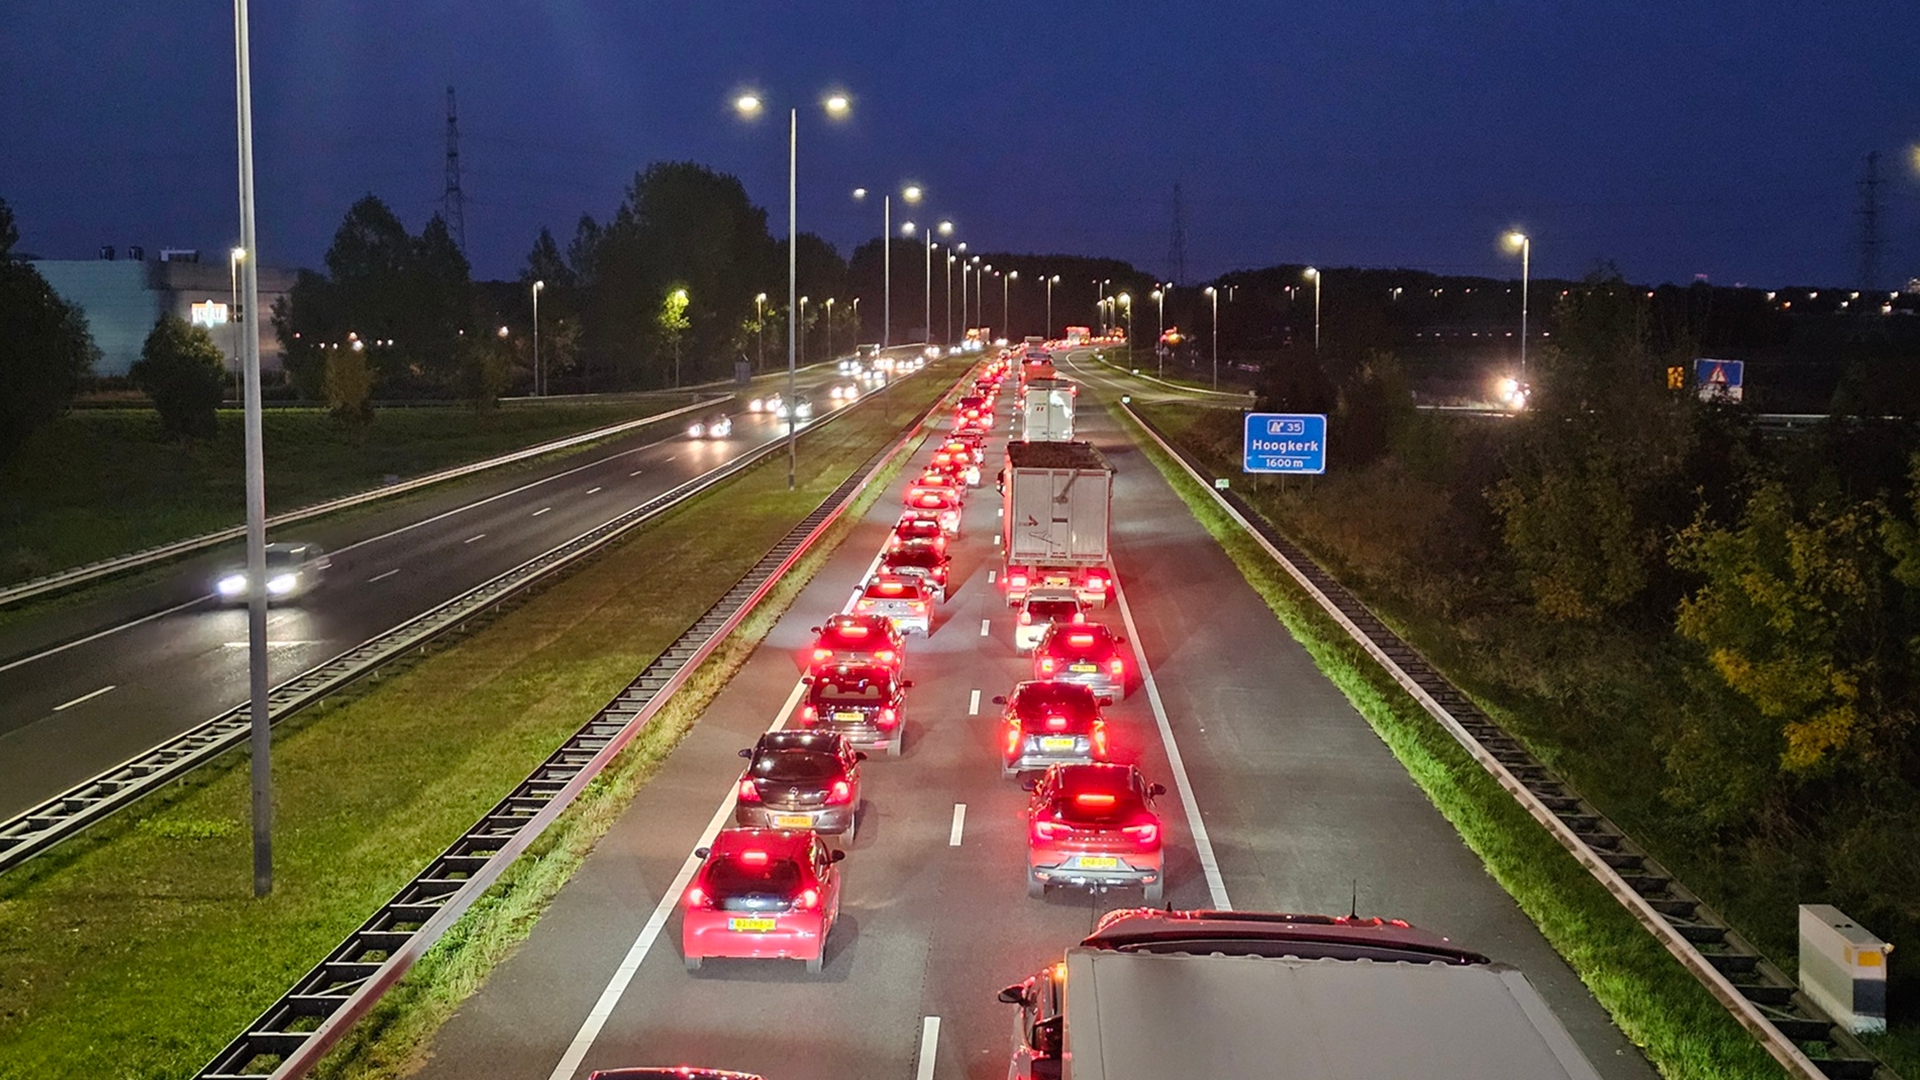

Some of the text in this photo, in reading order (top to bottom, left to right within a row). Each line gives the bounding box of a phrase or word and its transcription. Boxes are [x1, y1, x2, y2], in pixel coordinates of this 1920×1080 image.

[1287, 423, 1301, 432] 35
[1252, 439, 1319, 454] Hoogkerk
[1266, 458, 1304, 468] 1600 m
